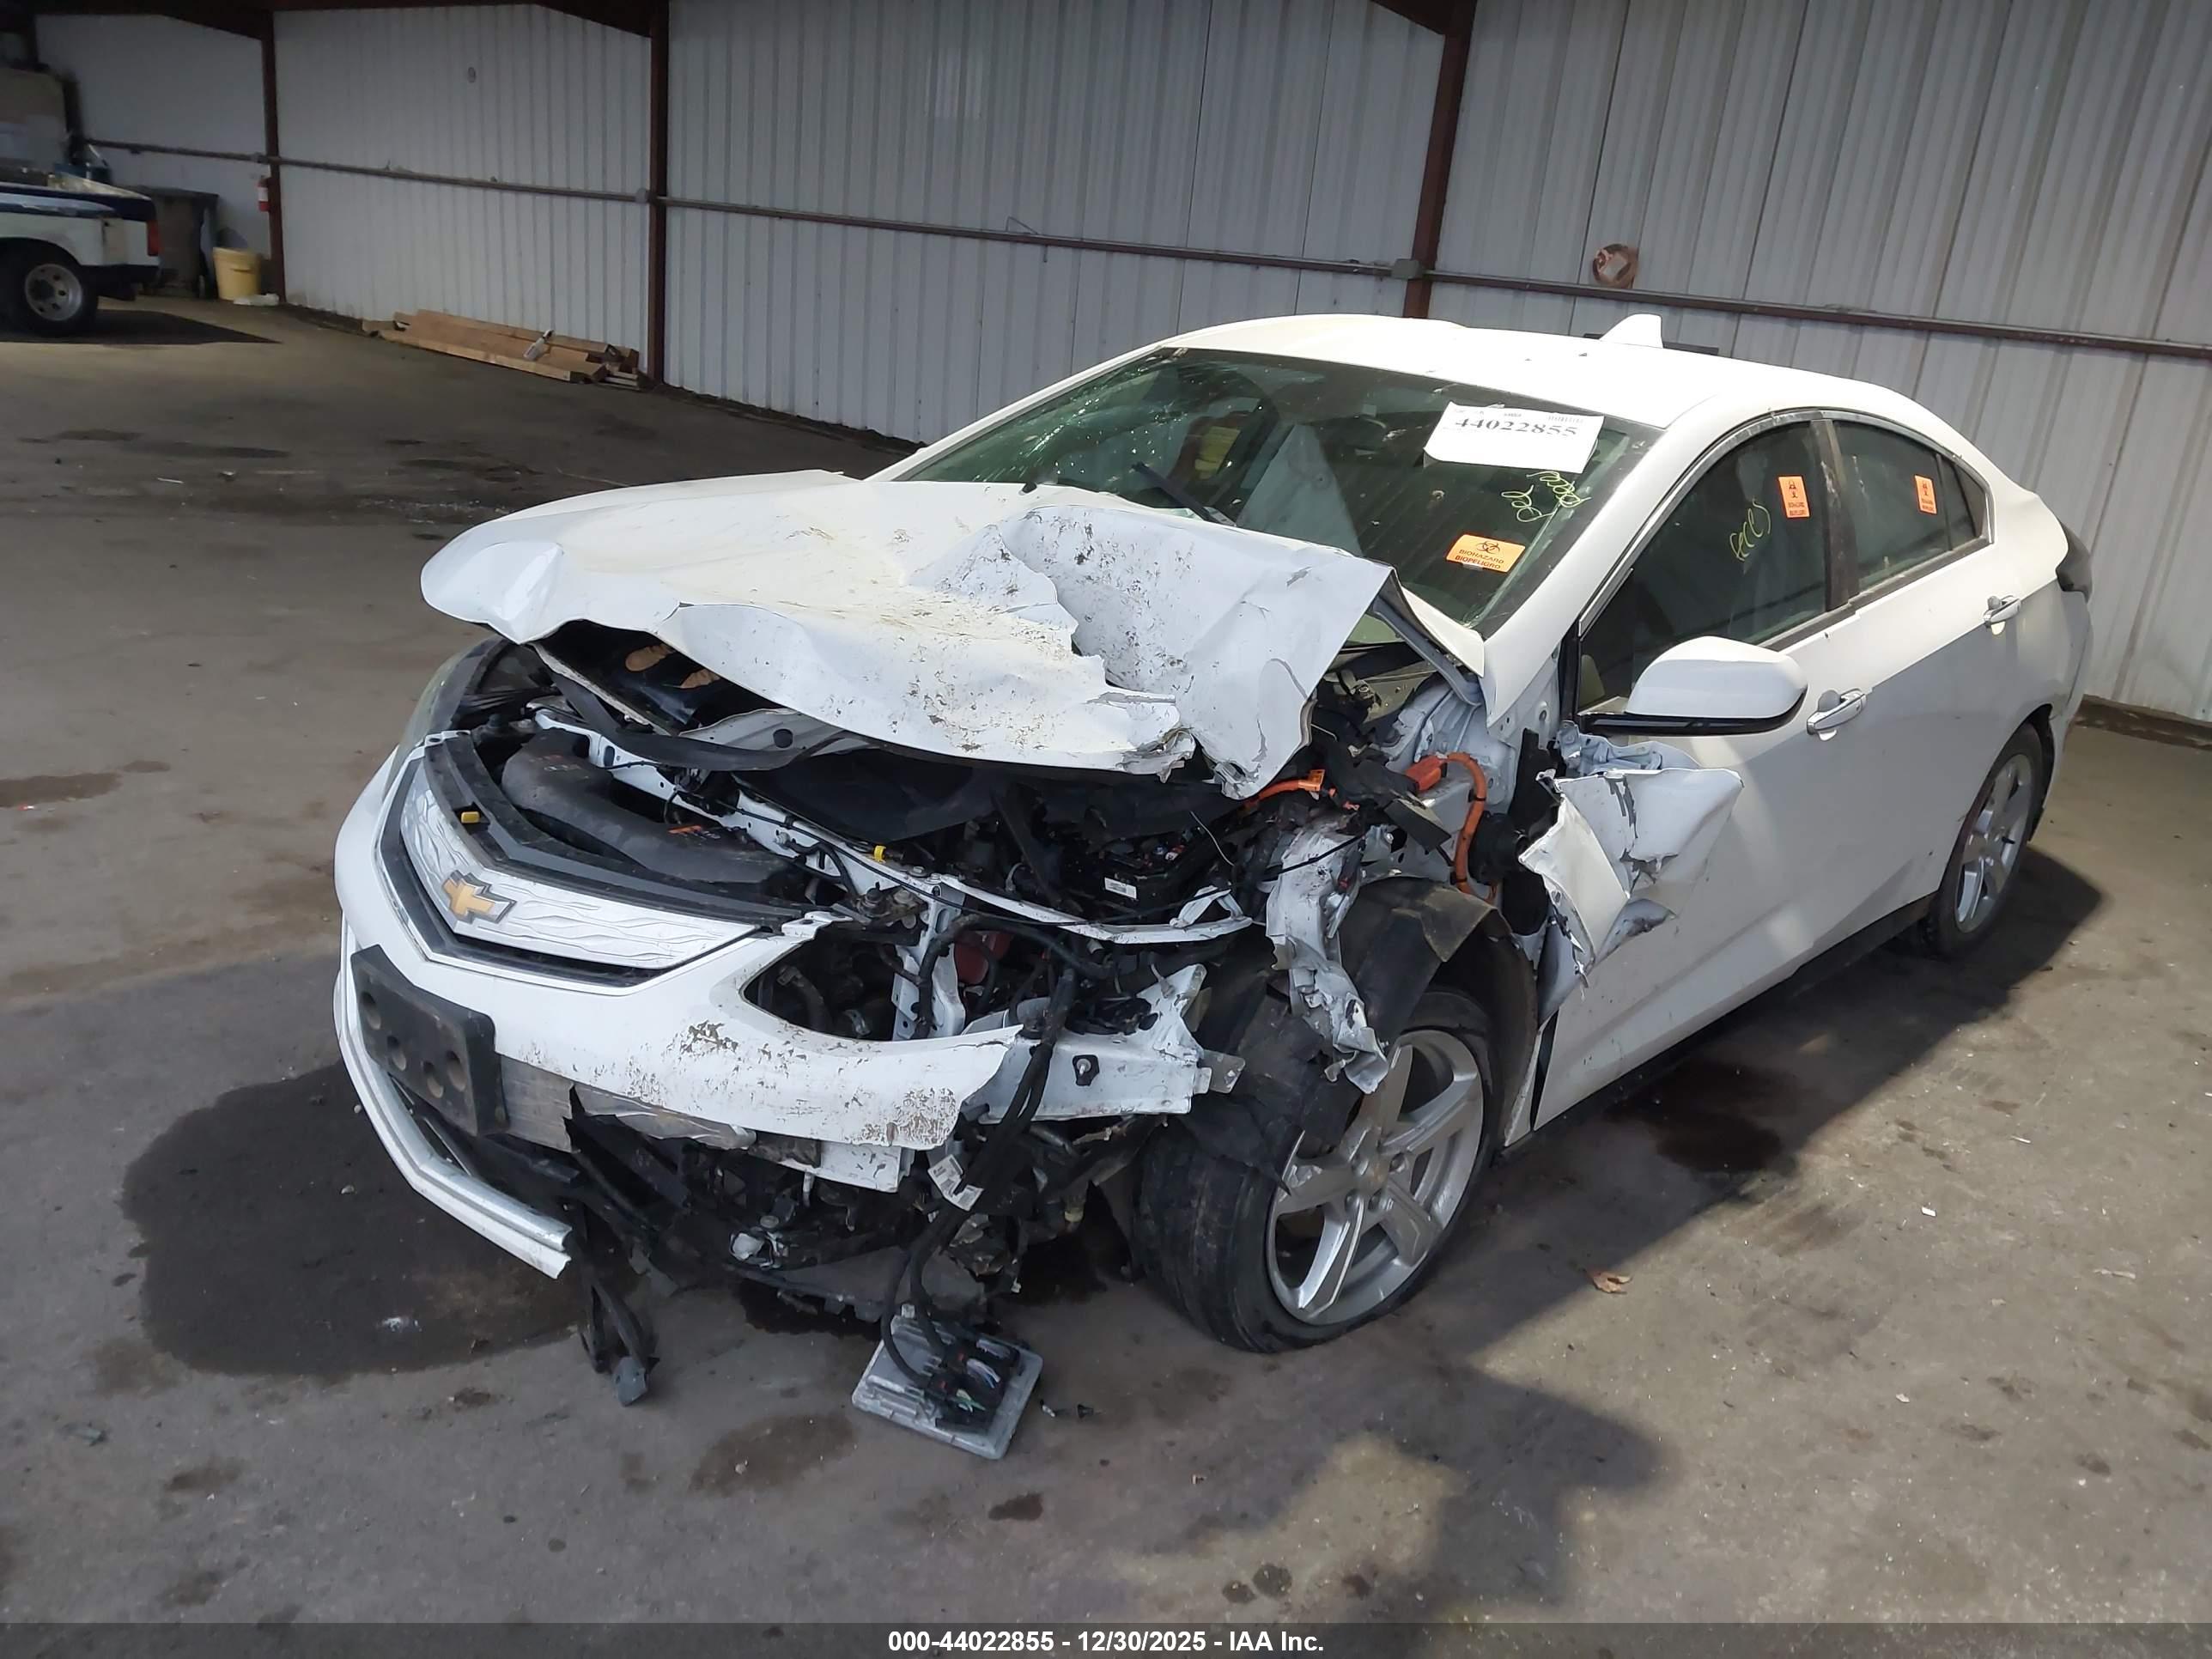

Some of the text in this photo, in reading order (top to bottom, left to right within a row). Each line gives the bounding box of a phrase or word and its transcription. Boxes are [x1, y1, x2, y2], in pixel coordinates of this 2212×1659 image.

[1455, 417, 1578, 437] 44022855
[1455, 555, 1501, 569] BIOPELIGRO
[1458, 549, 1504, 564] BIOHAZARD
